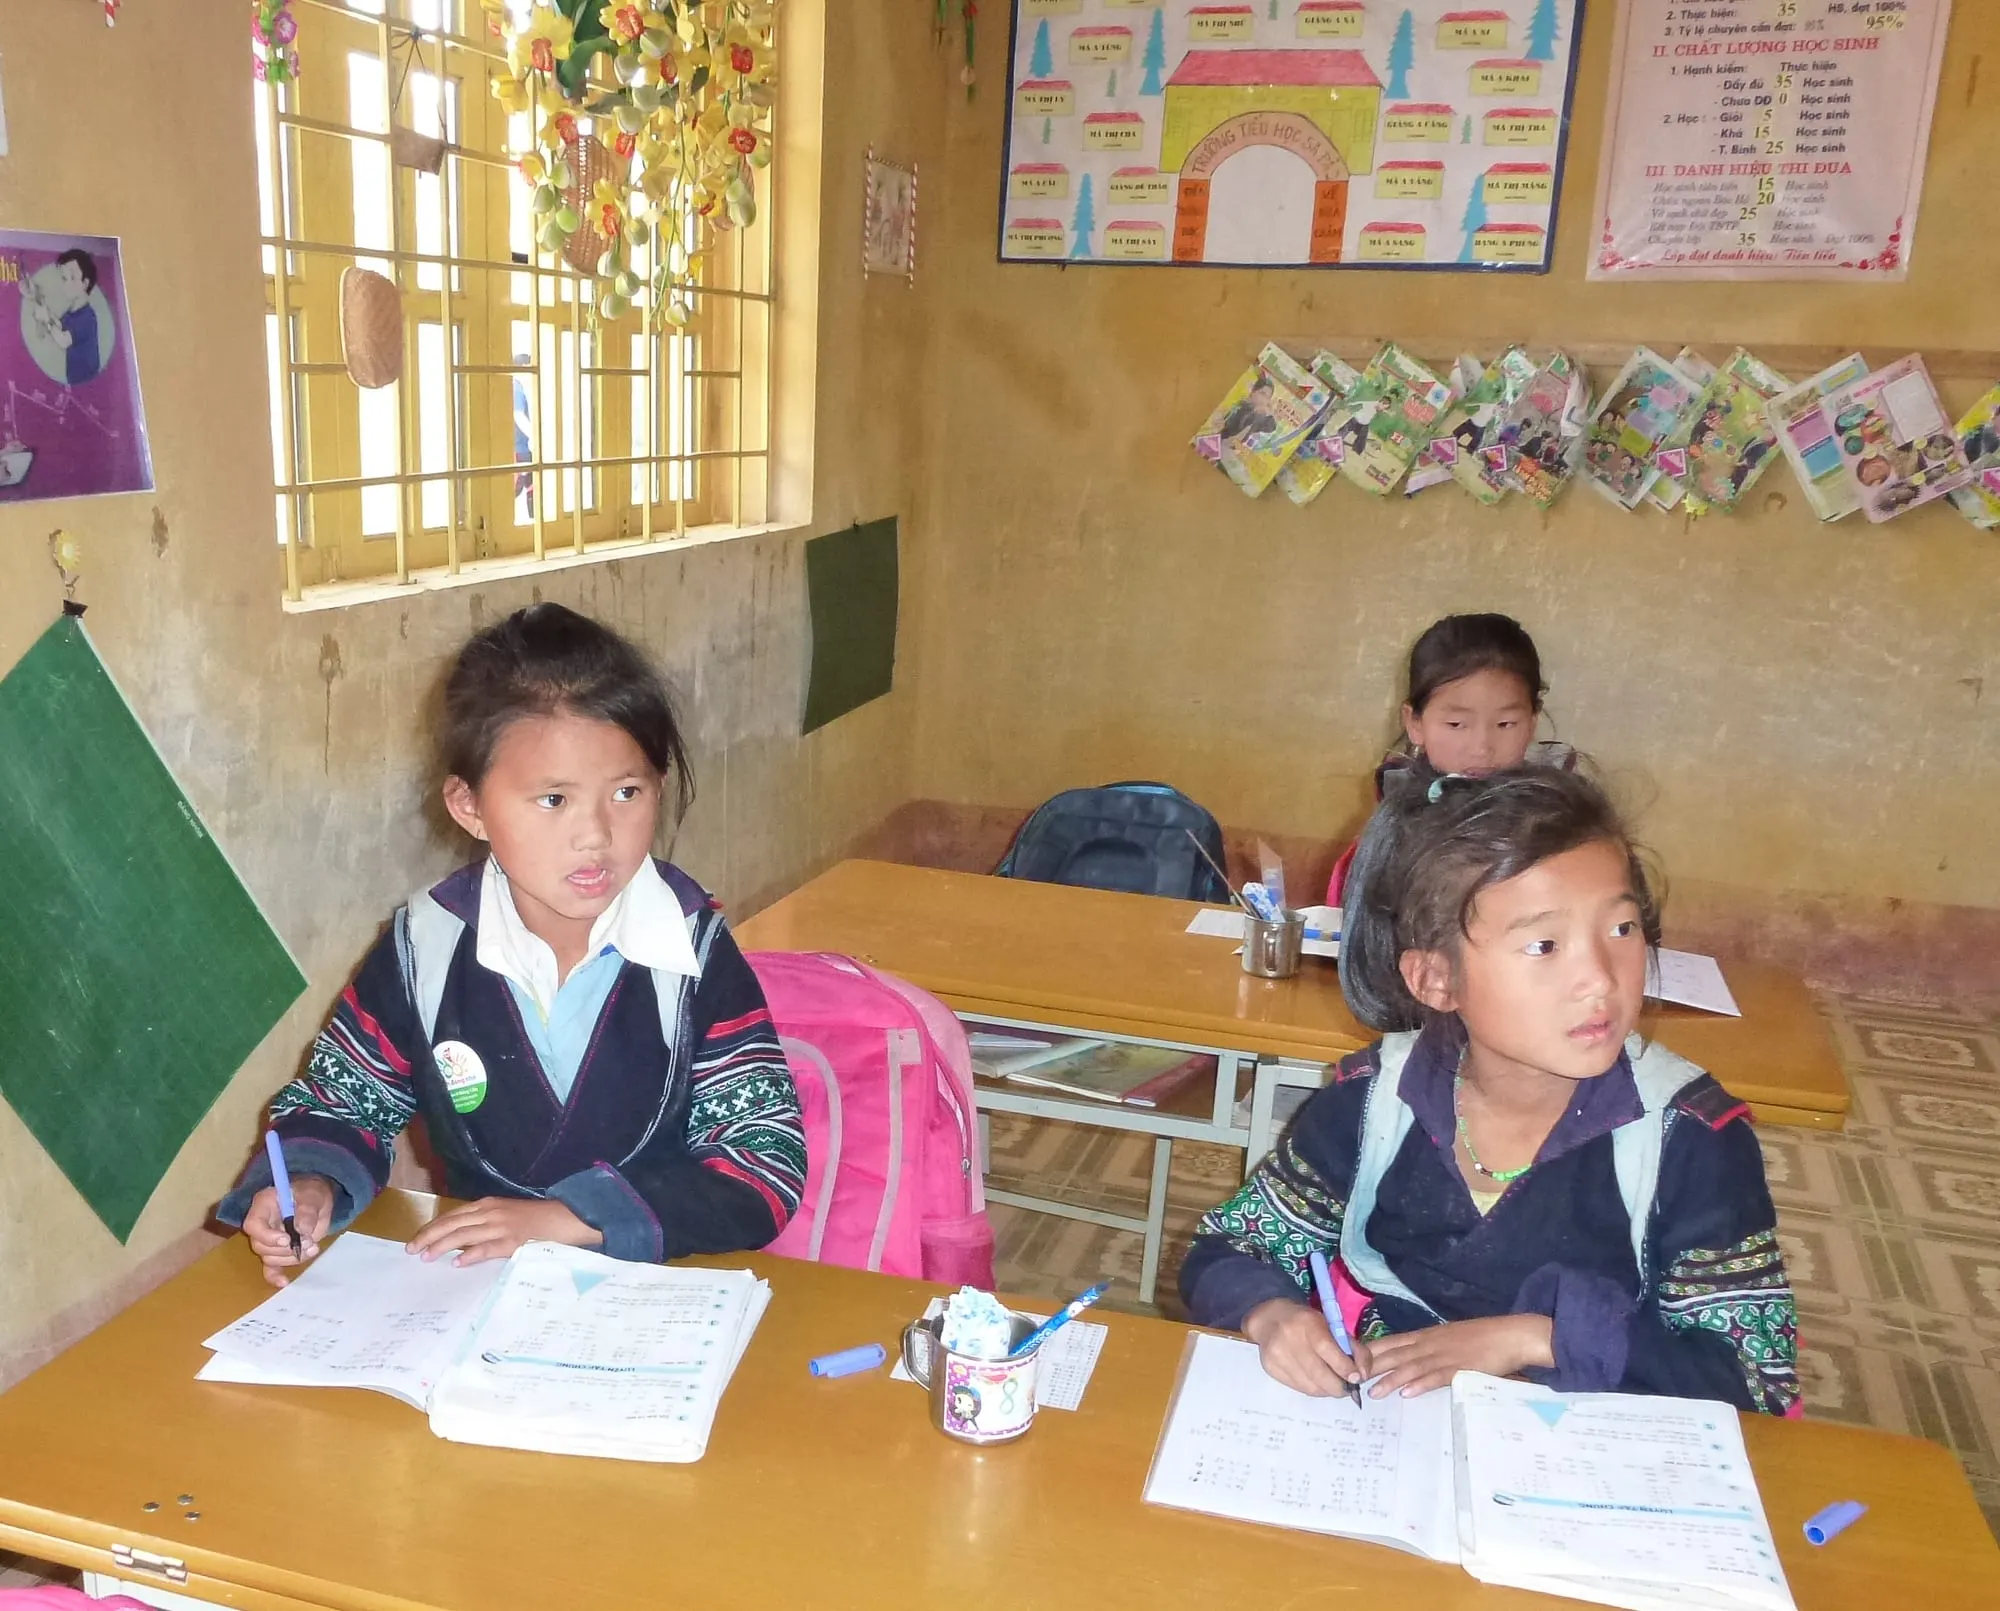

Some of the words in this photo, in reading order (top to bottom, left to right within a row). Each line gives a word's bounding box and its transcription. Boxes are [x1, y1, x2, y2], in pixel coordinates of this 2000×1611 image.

[1778, 3, 1796, 17] 35
[1866, 15, 1904, 29] 95%
[1674, 39, 1722, 56] CHẤT
[1726, 40, 1787, 57] LƯỢNG
[1792, 39, 1829, 54] HỌC
[1833, 37, 1880, 51] SINH
[1774, 74, 1793, 88] 35
[1829, 77, 1853, 87] sinh
[1827, 93, 1851, 104] sinh
[1763, 109, 1773, 121] 5
[1826, 109, 1850, 120] sinh
[1755, 126, 1770, 139] 15
[1821, 126, 1846, 136] sinh
[1765, 141, 1784, 154] 25
[1821, 143, 1846, 153] sinh
[1673, 163, 1725, 176] DANH
[1729, 160, 1772, 178] HIỆU
[1779, 162, 1809, 175] THI
[1813, 161, 1852, 174] ĐUA
[1758, 177, 1774, 191] 15
[1757, 192, 1775, 205] 20
[1739, 207, 1758, 220] 25
[1737, 232, 1756, 246] 35
